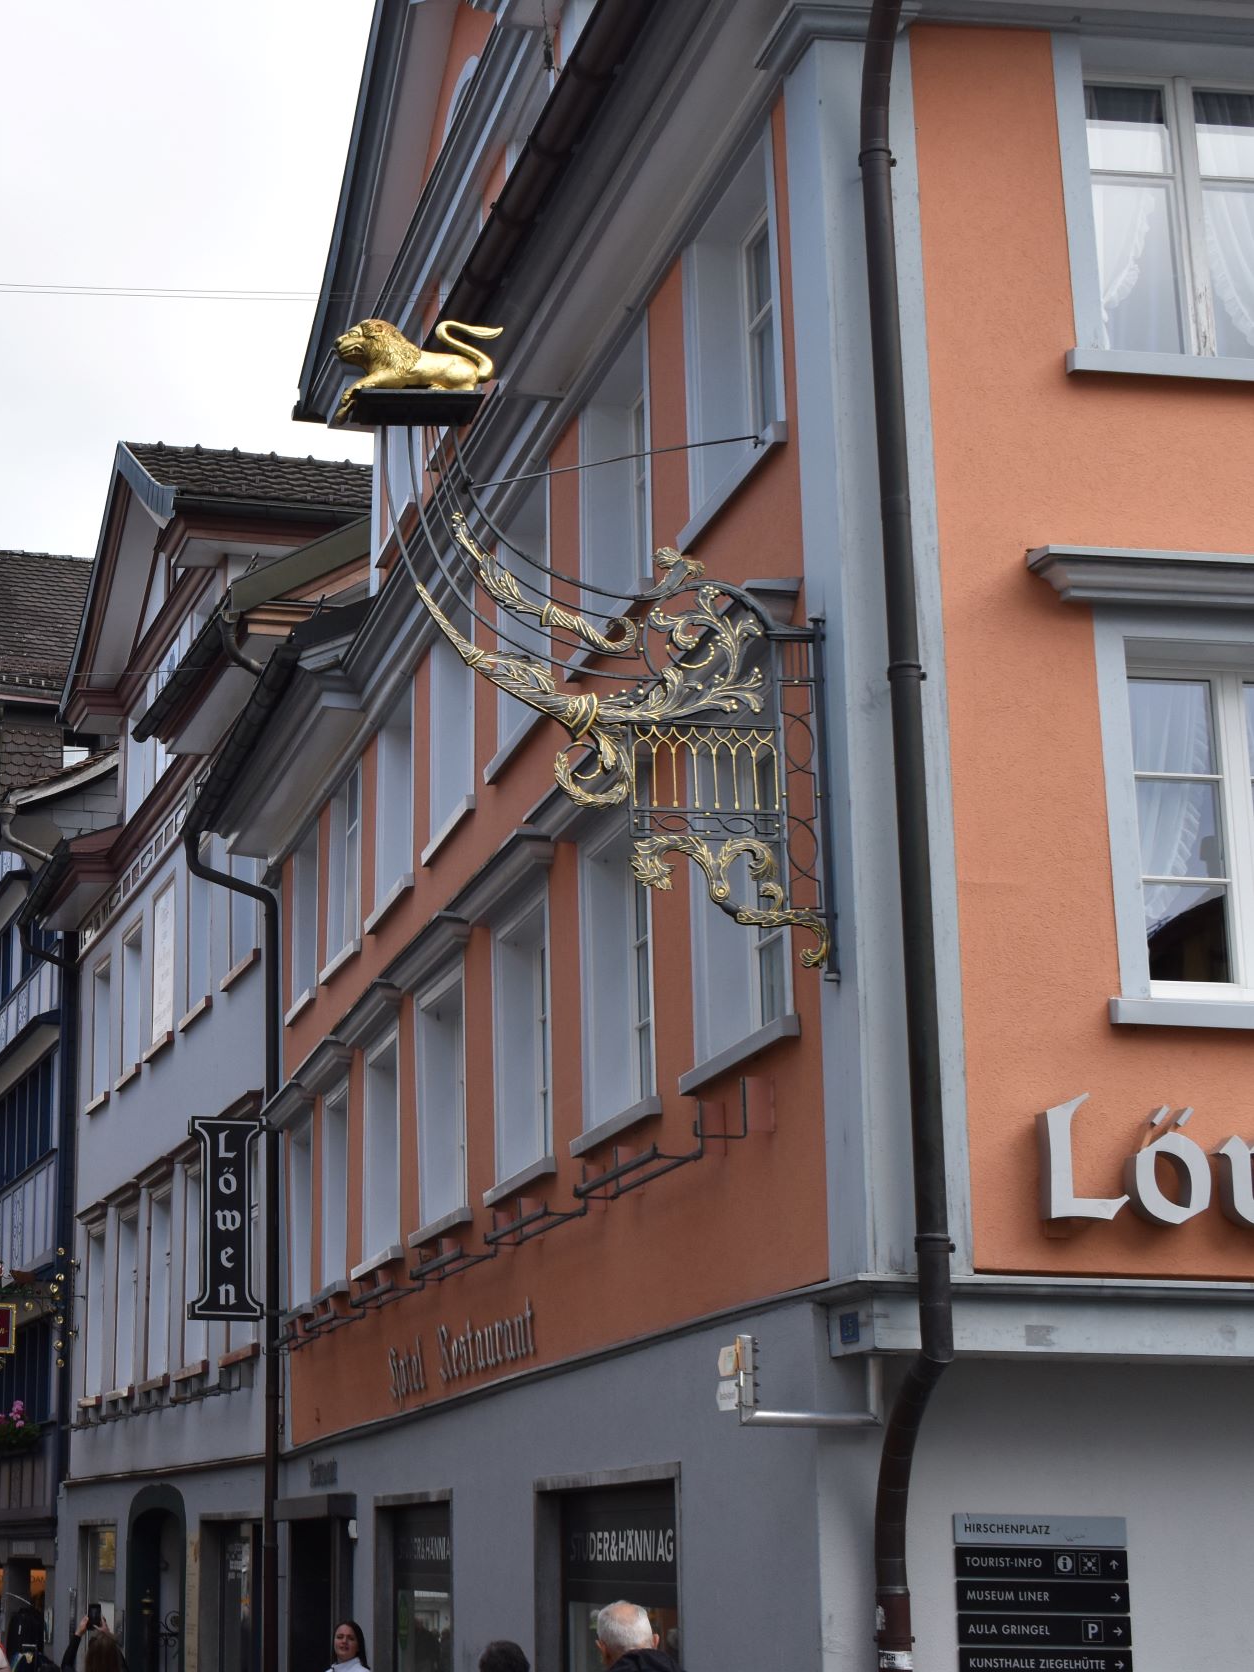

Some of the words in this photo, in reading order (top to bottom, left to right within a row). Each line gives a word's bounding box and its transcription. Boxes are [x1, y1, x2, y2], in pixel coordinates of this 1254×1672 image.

[214, 1129, 242, 1306] Löwen
[388, 1335, 426, 1409] Hotel
[436, 1296, 535, 1382] Restaurant
[964, 1522, 1051, 1535] HIRSCHENPLATZ
[964, 1556, 1043, 1569] TOURIST-INFO
[966, 1590, 1015, 1602] MUSEUM
[1019, 1591, 1050, 1602] LINER
[968, 1623, 998, 1634] AULA
[1002, 1624, 1051, 1636] GRINGEL
[969, 1658, 1036, 1669] KUNSTHALLE
[1039, 1656, 1106, 1670] ZIEGELHÜTTE
